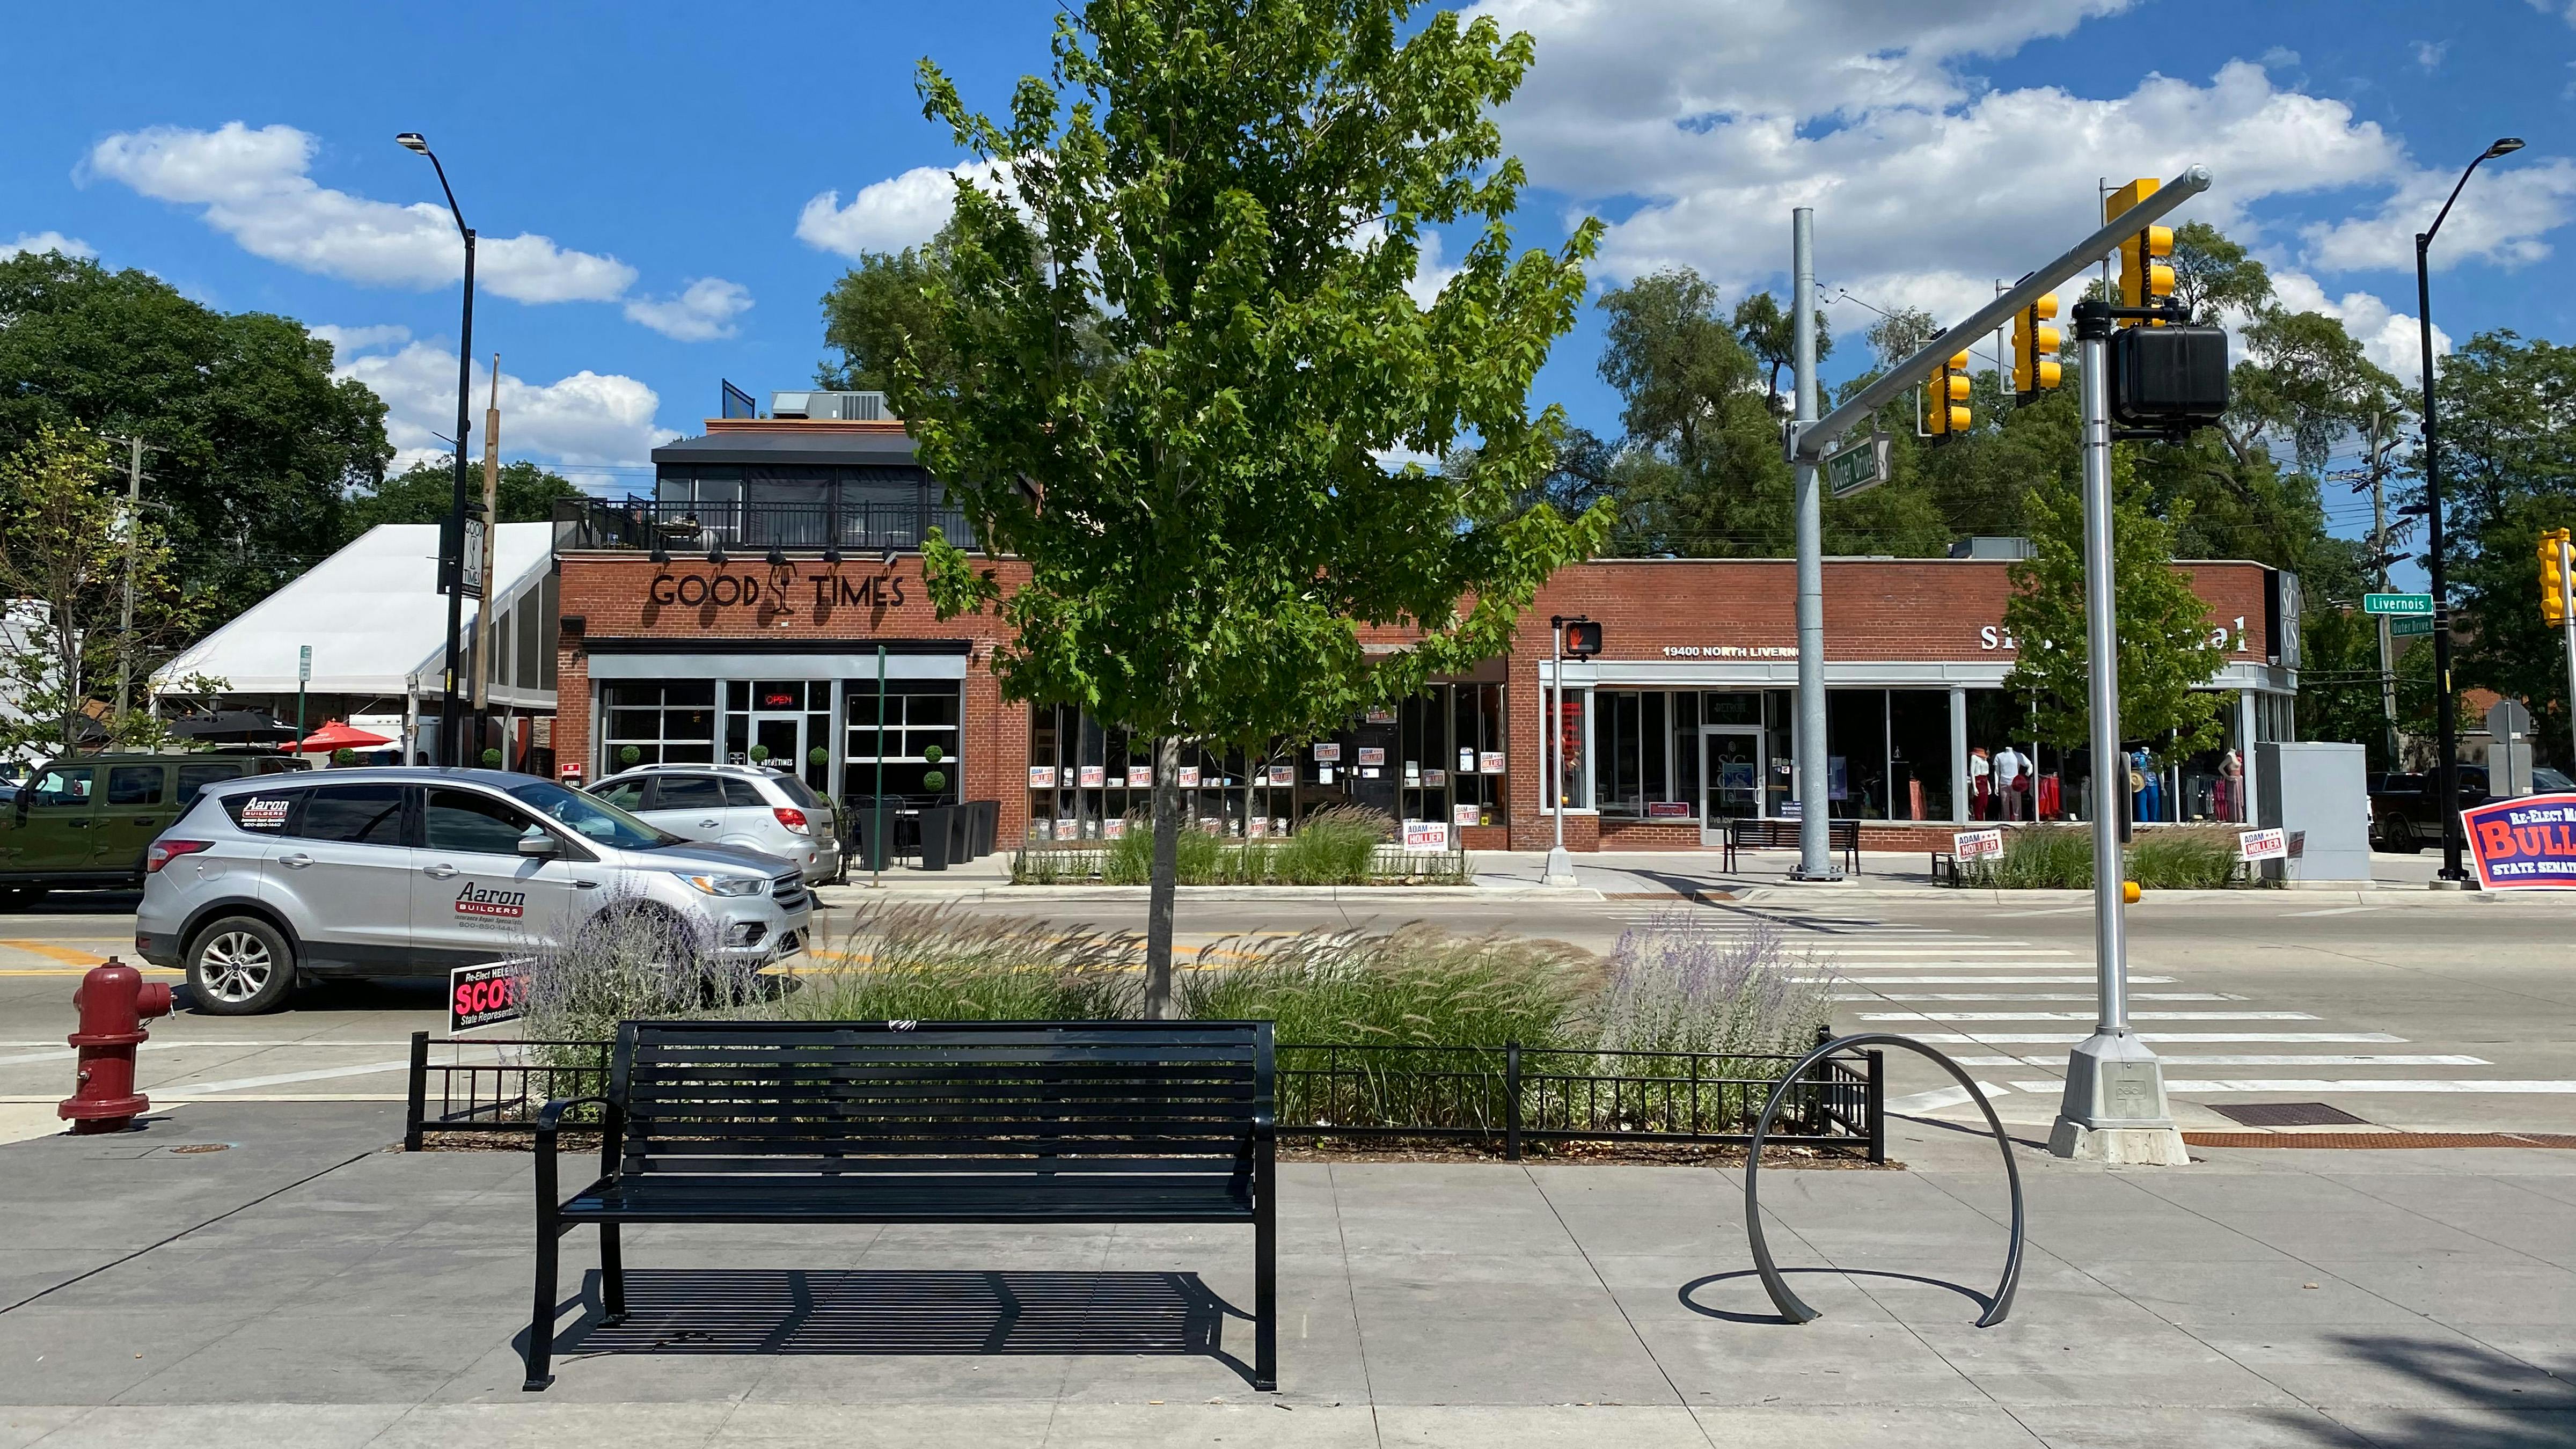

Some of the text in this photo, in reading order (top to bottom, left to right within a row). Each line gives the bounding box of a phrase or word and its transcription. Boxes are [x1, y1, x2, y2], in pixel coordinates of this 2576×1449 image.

[1832, 450, 1874, 488] Outer Drive
[464, 569, 480, 585] TIMES
[650, 574, 904, 607] GOOD TIMES
[2373, 597, 2425, 610] Livernois
[2394, 621, 2411, 633] Outer
[2412, 620, 2429, 632] Drive
[1663, 646, 1700, 657] 19400
[1703, 647, 1747, 657] NORTH
[766, 695, 792, 704] OPEN
[243, 797, 289, 810] Aaron
[1408, 825, 1428, 833] ADAM
[1409, 833, 1443, 844] HOLLIER
[1959, 834, 1980, 844] ADAM
[2245, 832, 2264, 843] ADAM
[1962, 840, 1996, 855] HOLLIER
[2247, 839, 2280, 853] HOLLIER
[2492, 862, 2536, 875] STATE
[457, 882, 525, 905] Aaron
[459, 904, 518, 914] BUILDERS
[465, 965, 518, 982] Re-Elect HELE
[461, 1007, 515, 1026] State Representa
